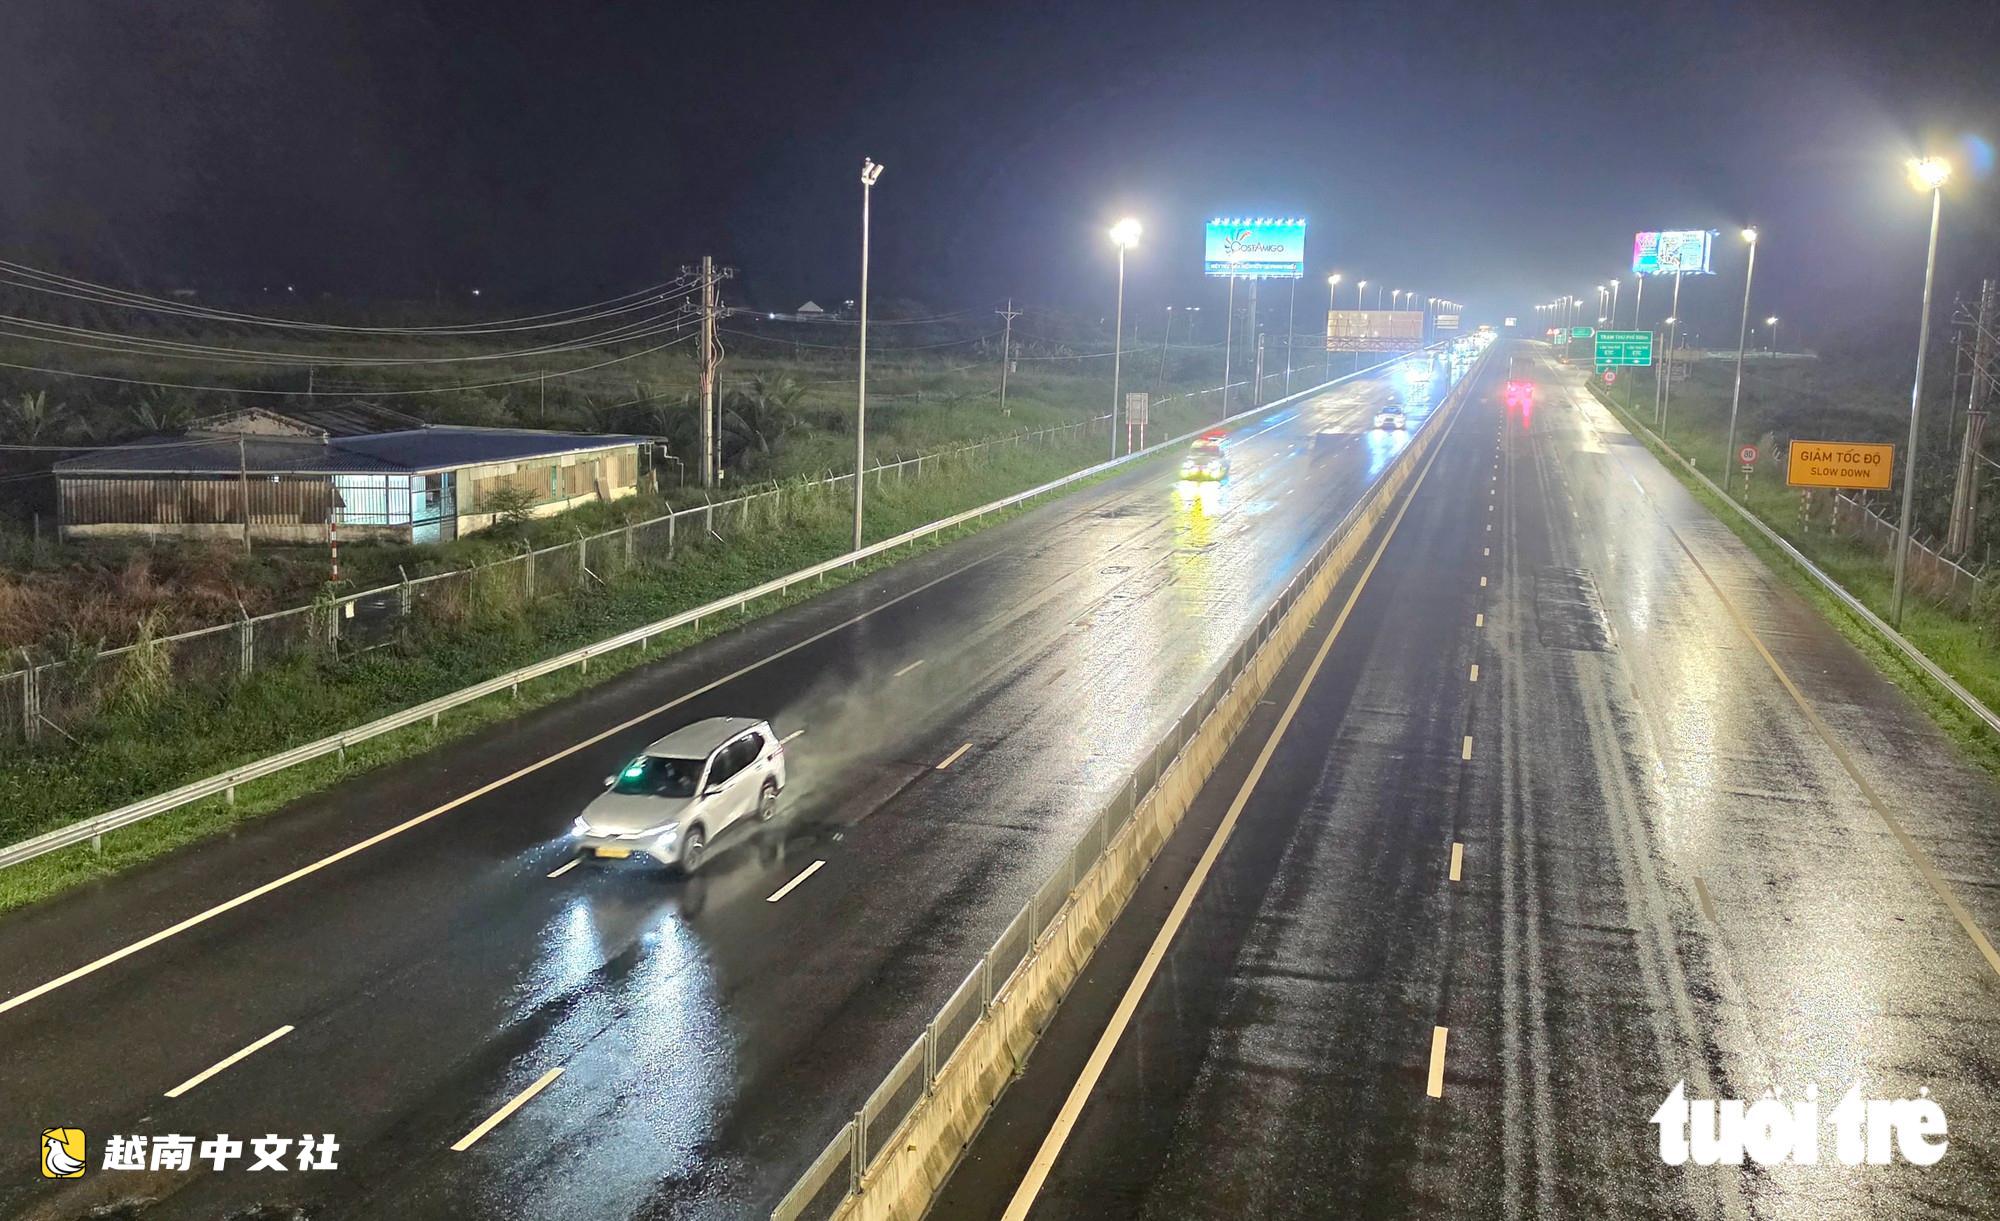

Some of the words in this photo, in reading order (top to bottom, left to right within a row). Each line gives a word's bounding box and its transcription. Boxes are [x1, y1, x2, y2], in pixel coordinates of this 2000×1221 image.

[1800, 448, 1833, 462] GIẢM
[1837, 449, 1861, 464] TỐC
[1863, 451, 1881, 467] ĐỘ
[1810, 467, 1838, 476] SLOW
[1840, 468, 1871, 478] DOWN
